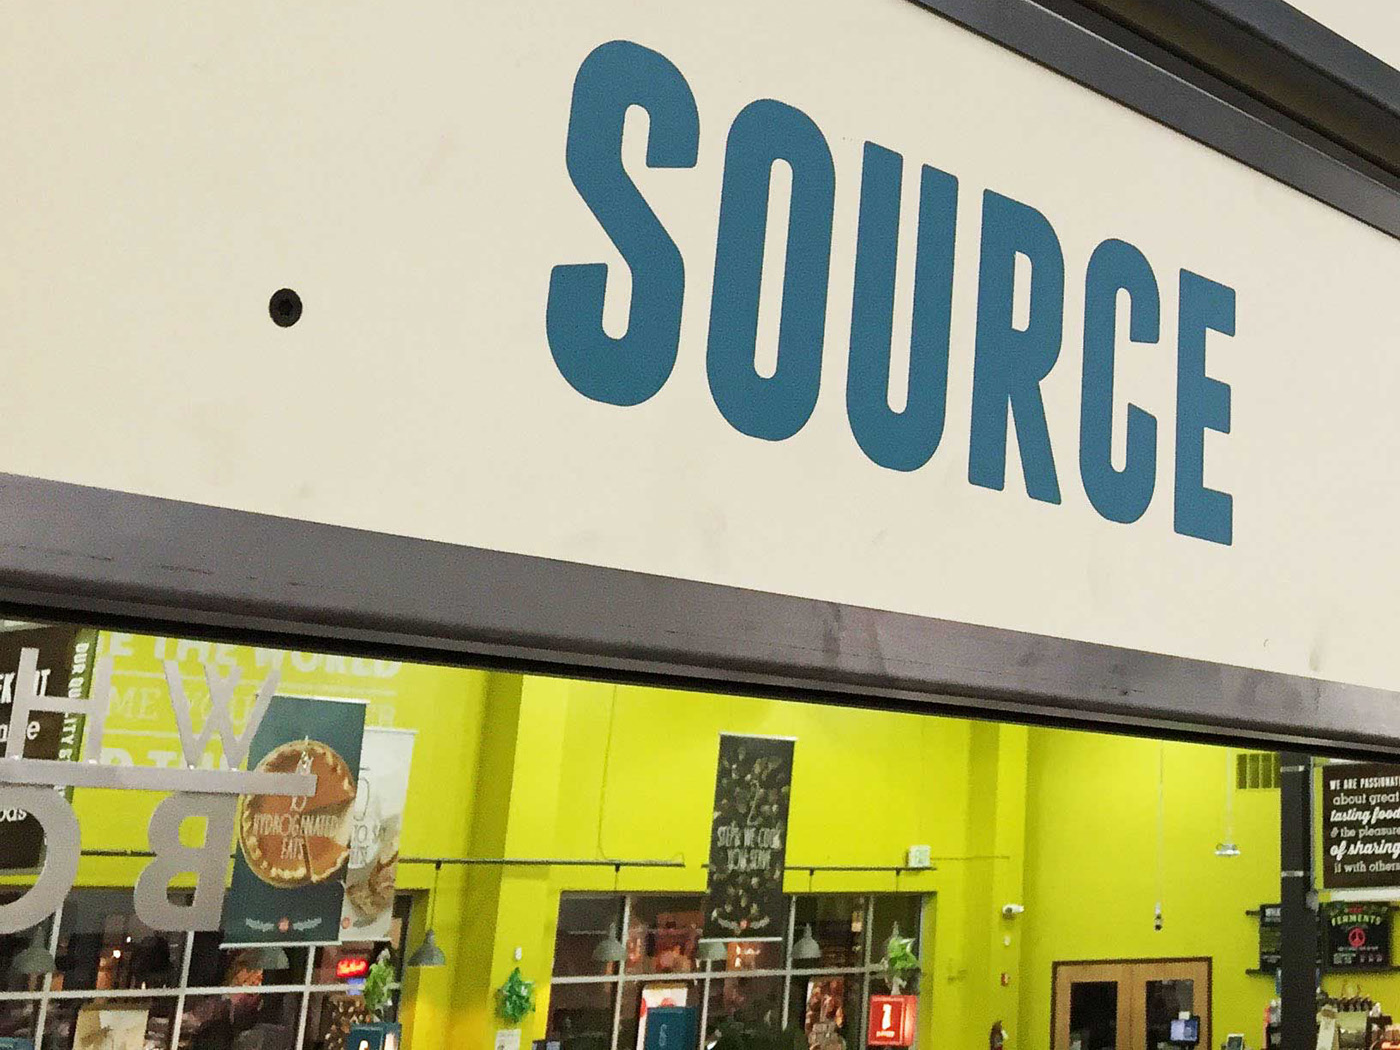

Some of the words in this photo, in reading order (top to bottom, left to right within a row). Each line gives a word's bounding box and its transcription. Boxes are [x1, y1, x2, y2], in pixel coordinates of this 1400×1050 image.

[546, 40, 1236, 545] SOURCE
[72, 642, 90, 674] OUR
[1330, 780, 1341, 790] WE
[1343, 779, 1358, 790] ARE
[1332, 793, 1366, 805] about
[1369, 791, 1400, 805] great
[1330, 808, 1371, 825] tasting
[1340, 826, 1356, 838] the
[1330, 840, 1347, 861] of
[1334, 862, 1341, 874] it
[1344, 860, 1367, 873] with
[1331, 914, 1382, 927] FERMENTS
